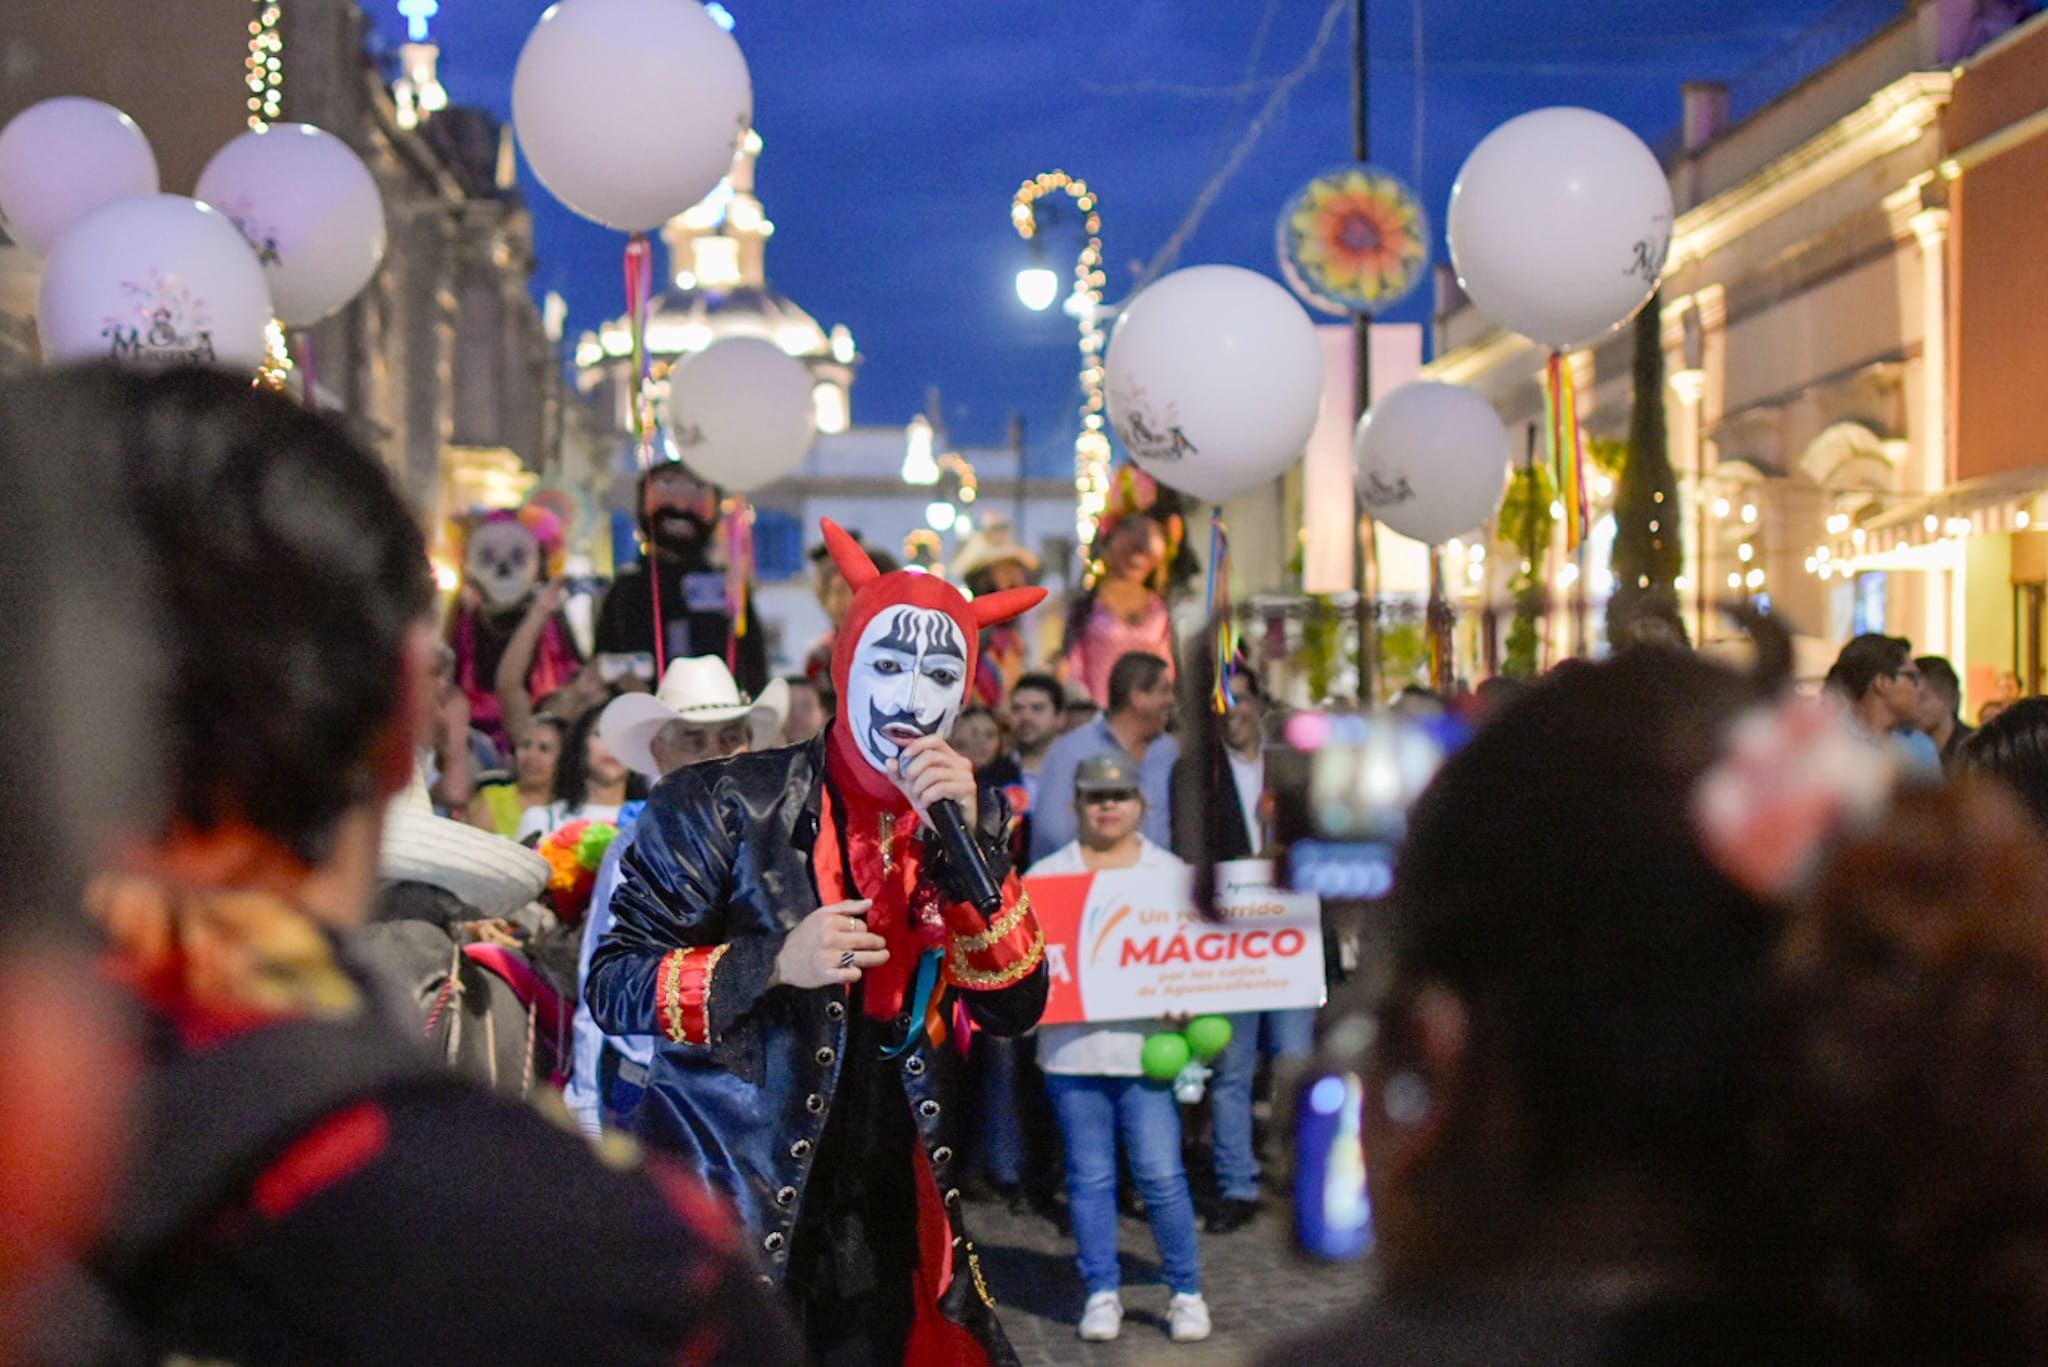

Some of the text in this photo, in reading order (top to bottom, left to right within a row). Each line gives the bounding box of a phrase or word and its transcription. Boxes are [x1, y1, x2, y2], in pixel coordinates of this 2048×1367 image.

[1139, 901, 1286, 924] Un reorrido
[1119, 924, 1306, 968] MÁGICO
